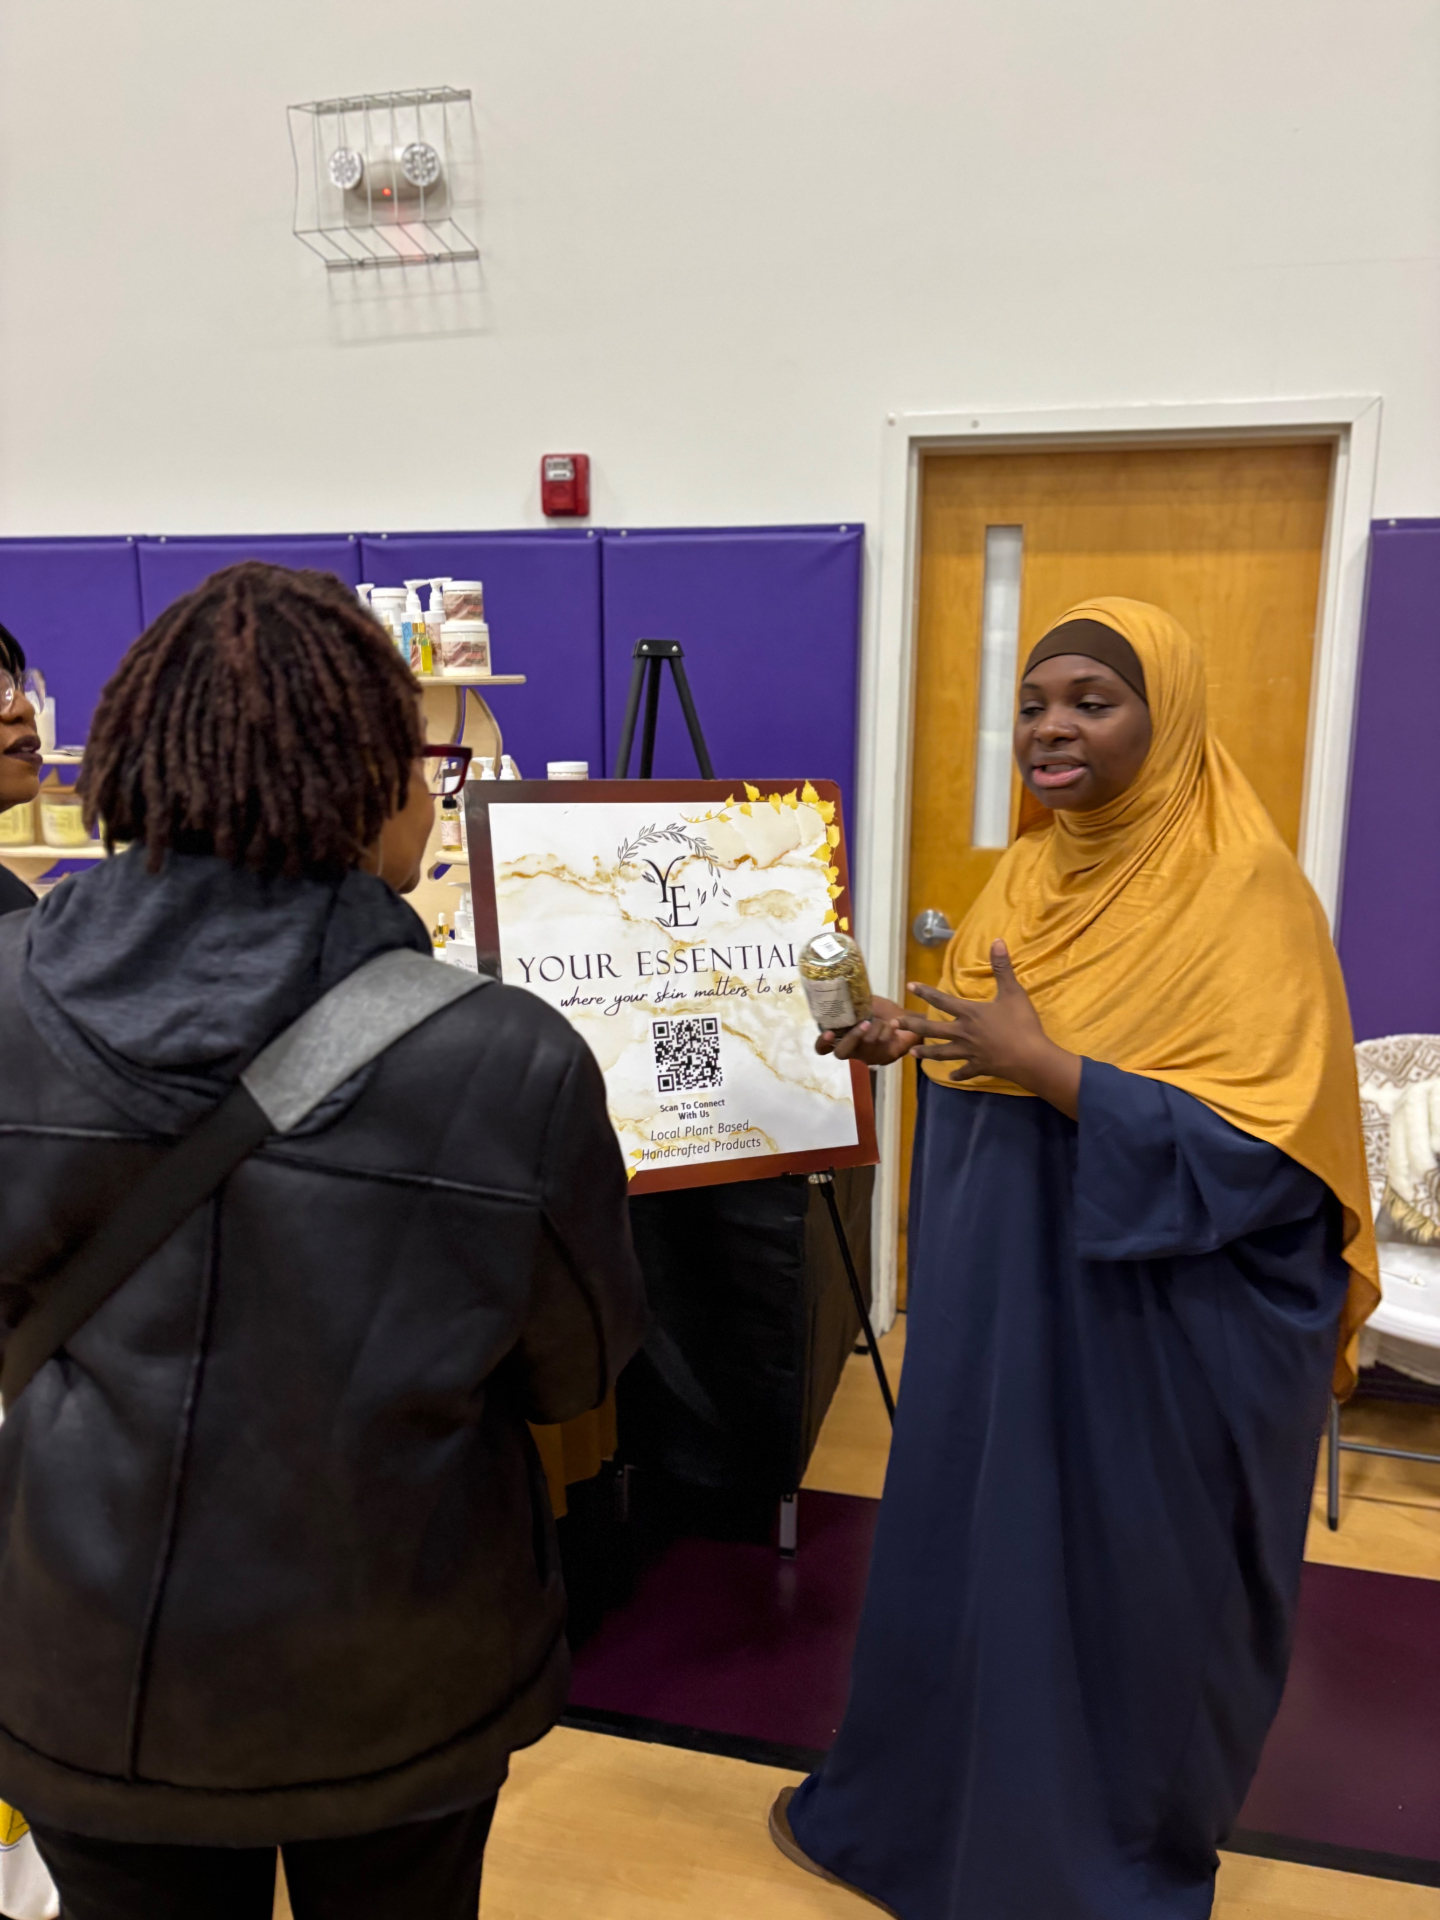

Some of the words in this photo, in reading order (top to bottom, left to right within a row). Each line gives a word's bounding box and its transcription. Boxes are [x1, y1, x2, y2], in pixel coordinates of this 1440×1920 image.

[517, 953, 622, 983] YOUR
[561, 986, 606, 1007] where
[603, 993, 648, 1016] your
[654, 980, 687, 1003] skin
[694, 975, 750, 998] matters
[756, 973, 771, 994] to
[779, 982, 795, 994] us
[660, 1104, 678, 1113] Scan
[681, 1102, 691, 1111] To
[694, 1099, 725, 1109] Connect
[678, 1110, 697, 1120] With
[700, 1110, 710, 1118] Us
[650, 1127, 680, 1141] Local
[685, 1125, 714, 1137] Plant
[718, 1119, 749, 1134] Based
[641, 1142, 710, 1161] Handcrafted
[714, 1137, 761, 1152] Products
